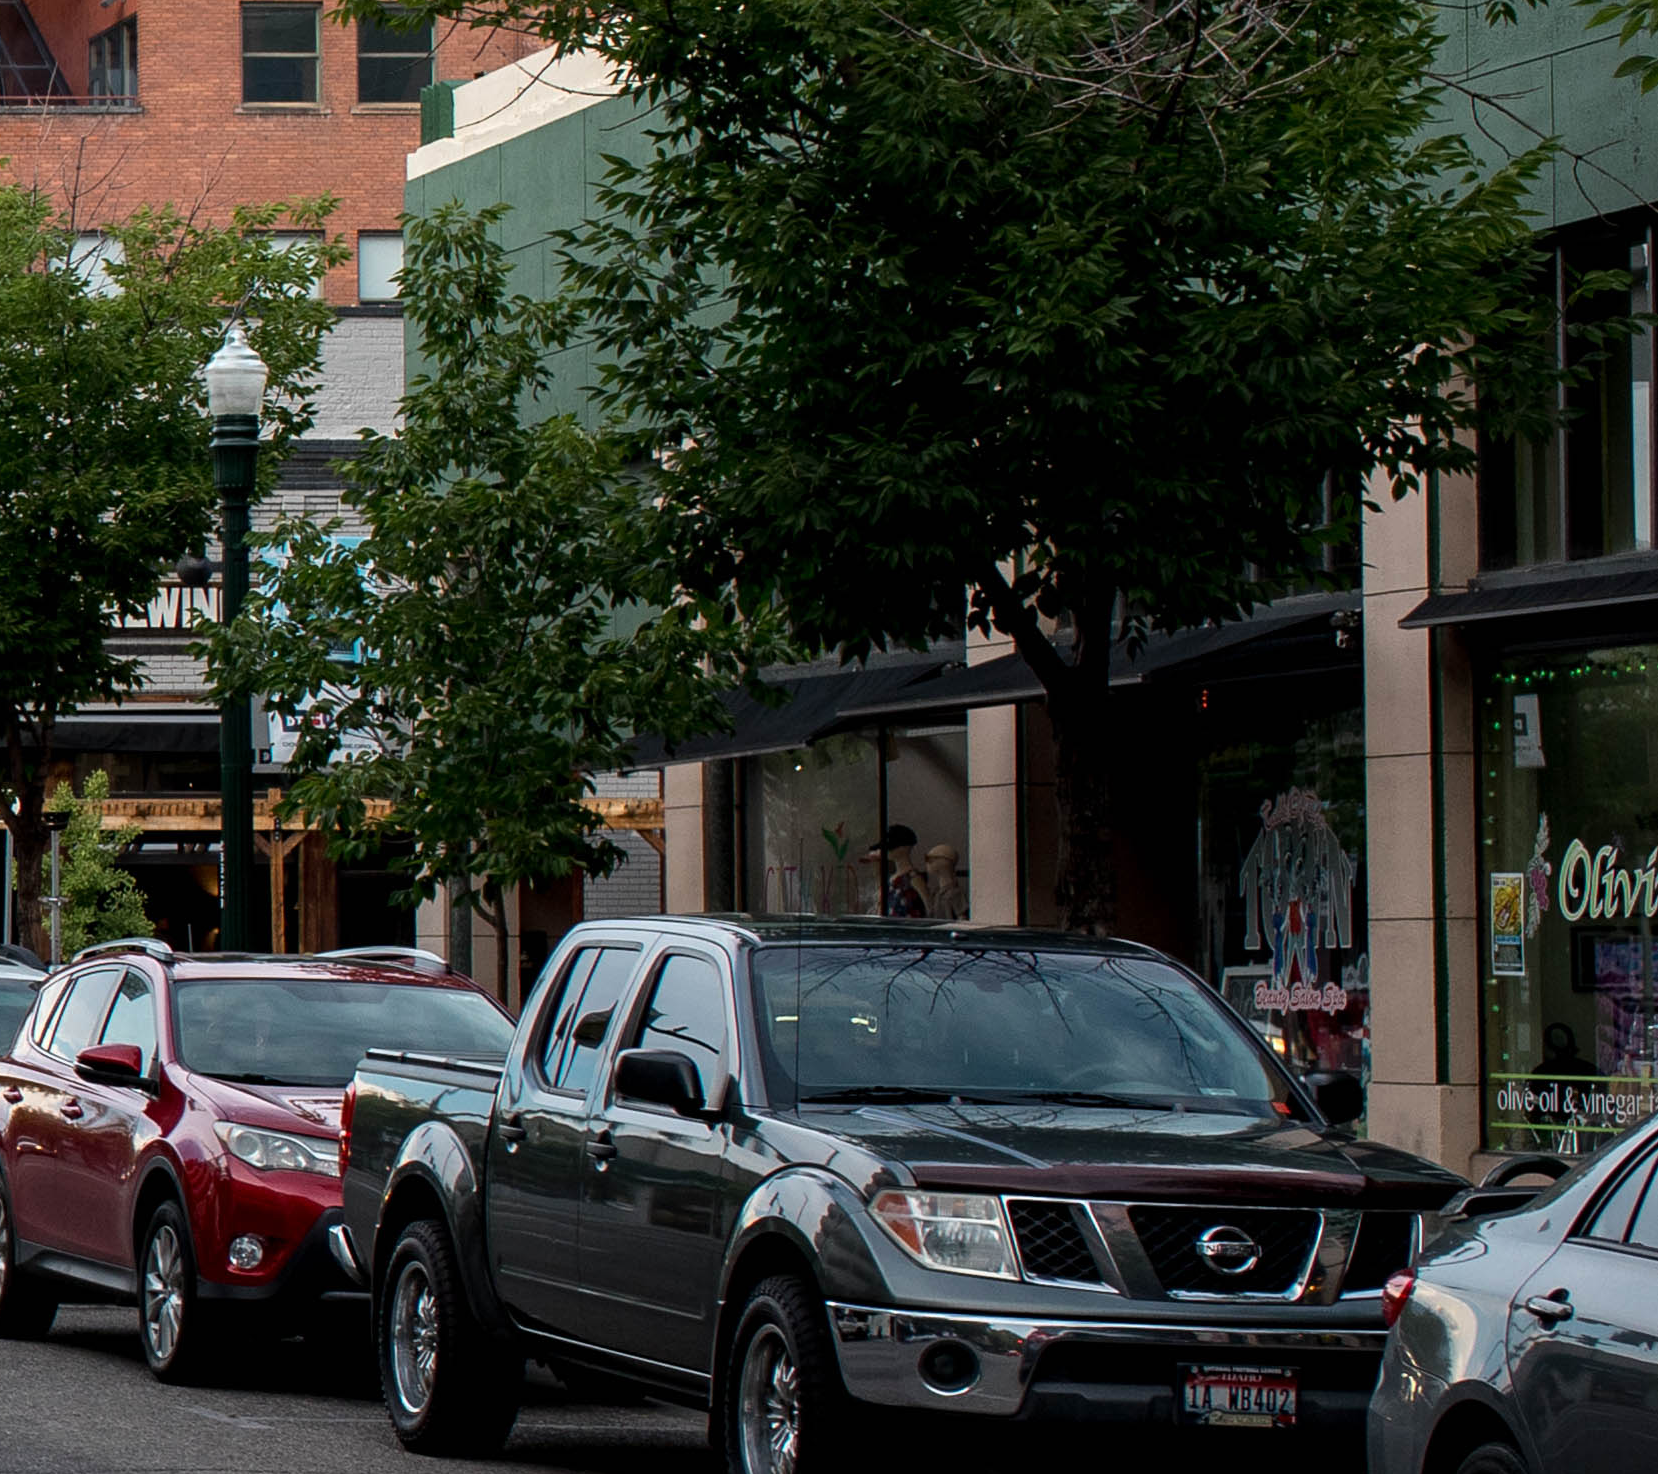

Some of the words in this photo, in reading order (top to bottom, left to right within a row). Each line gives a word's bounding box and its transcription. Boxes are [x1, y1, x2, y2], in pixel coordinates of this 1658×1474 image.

[1559, 837, 1658, 922] Olivi
[1497, 1081, 1535, 1112] olive
[1539, 1082, 1559, 1113] oil
[1563, 1086, 1578, 1114] &
[1582, 1084, 1643, 1124] vinegar
[1188, 1385, 1213, 1409] 1A
